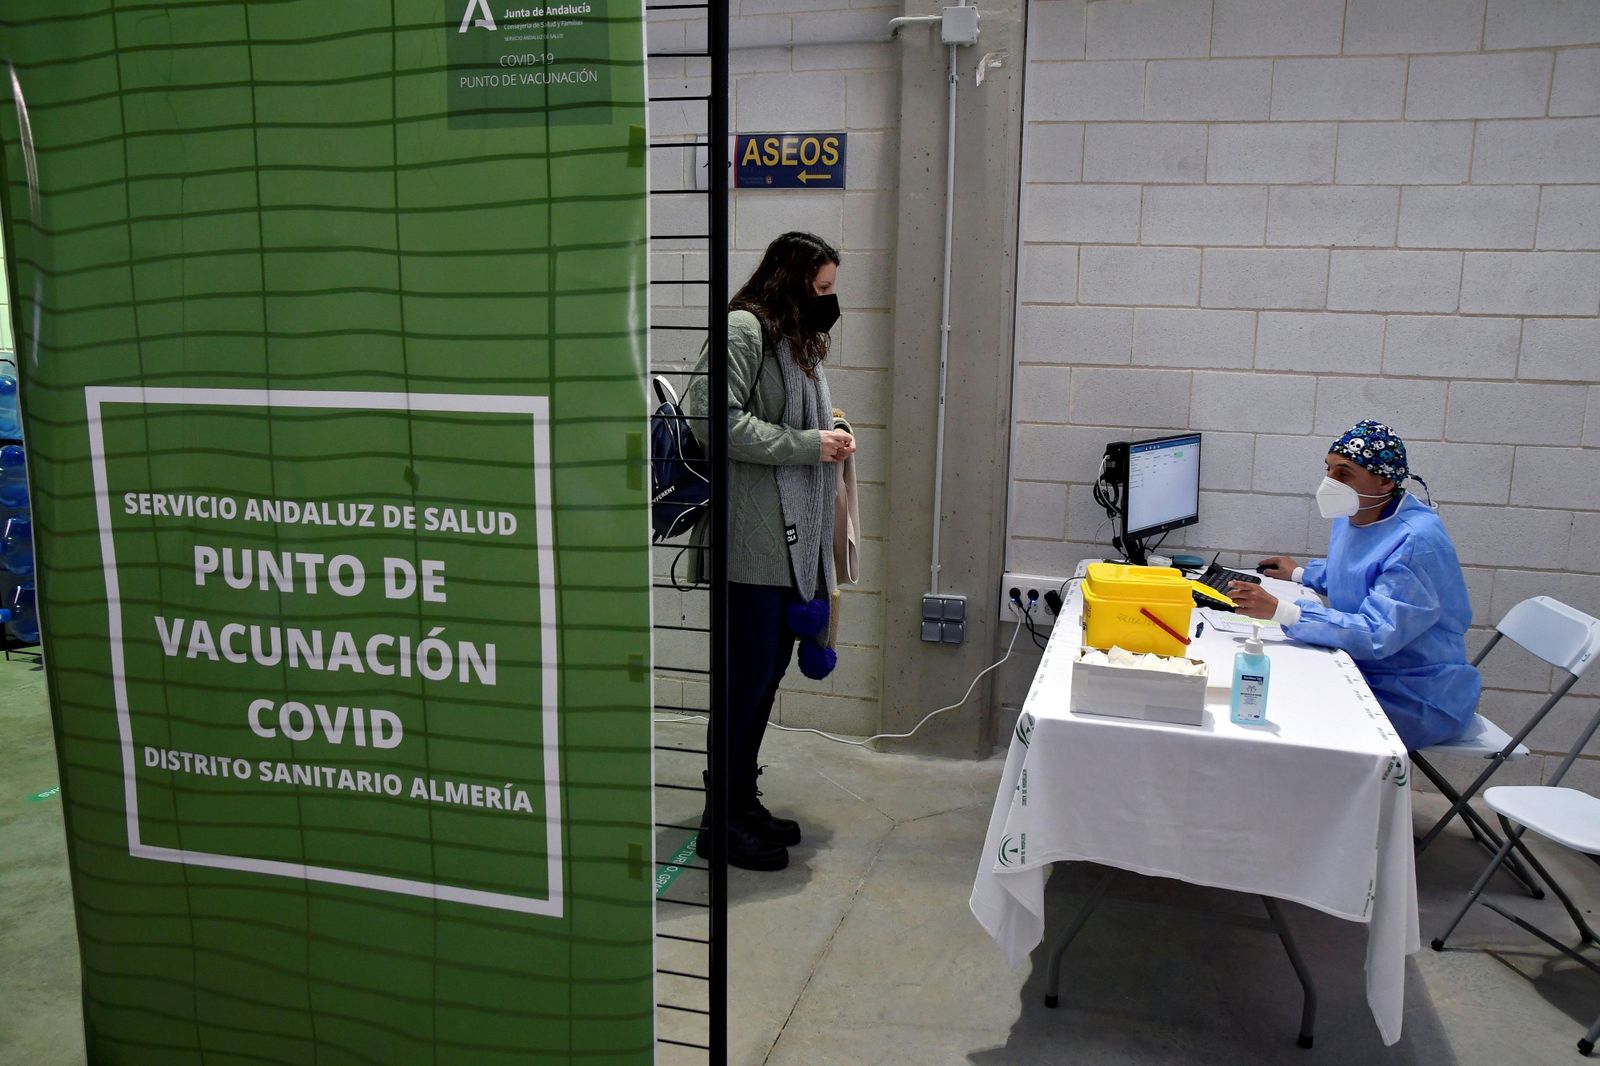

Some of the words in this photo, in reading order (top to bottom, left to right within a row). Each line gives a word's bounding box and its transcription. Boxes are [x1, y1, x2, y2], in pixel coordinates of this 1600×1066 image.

[503, 8, 531, 19] Junta
[532, 7, 544, 17] de
[545, 2, 591, 16] Andalucía
[541, 20, 557, 28] Slud
[460, 74, 499, 89] PUNTO
[502, 73, 517, 86] DE
[519, 68, 598, 86] VACUNACIÓN
[499, 52, 554, 68] COVID-19
[741, 137, 839, 167] ASEOS
[124, 492, 237, 520] SERVICIO
[244, 498, 376, 527] ANDALUZ
[383, 504, 417, 530] DE
[424, 507, 518, 536] SALUD
[194, 545, 366, 597] PUNTO
[383, 557, 447, 603] DE
[154, 615, 497, 686] VACUNACIÓN
[247, 698, 404, 750] COVID
[144, 746, 252, 780] DISTRITO
[258, 760, 403, 797] SANITARIO
[409, 777, 533, 814] ALMERÍA
